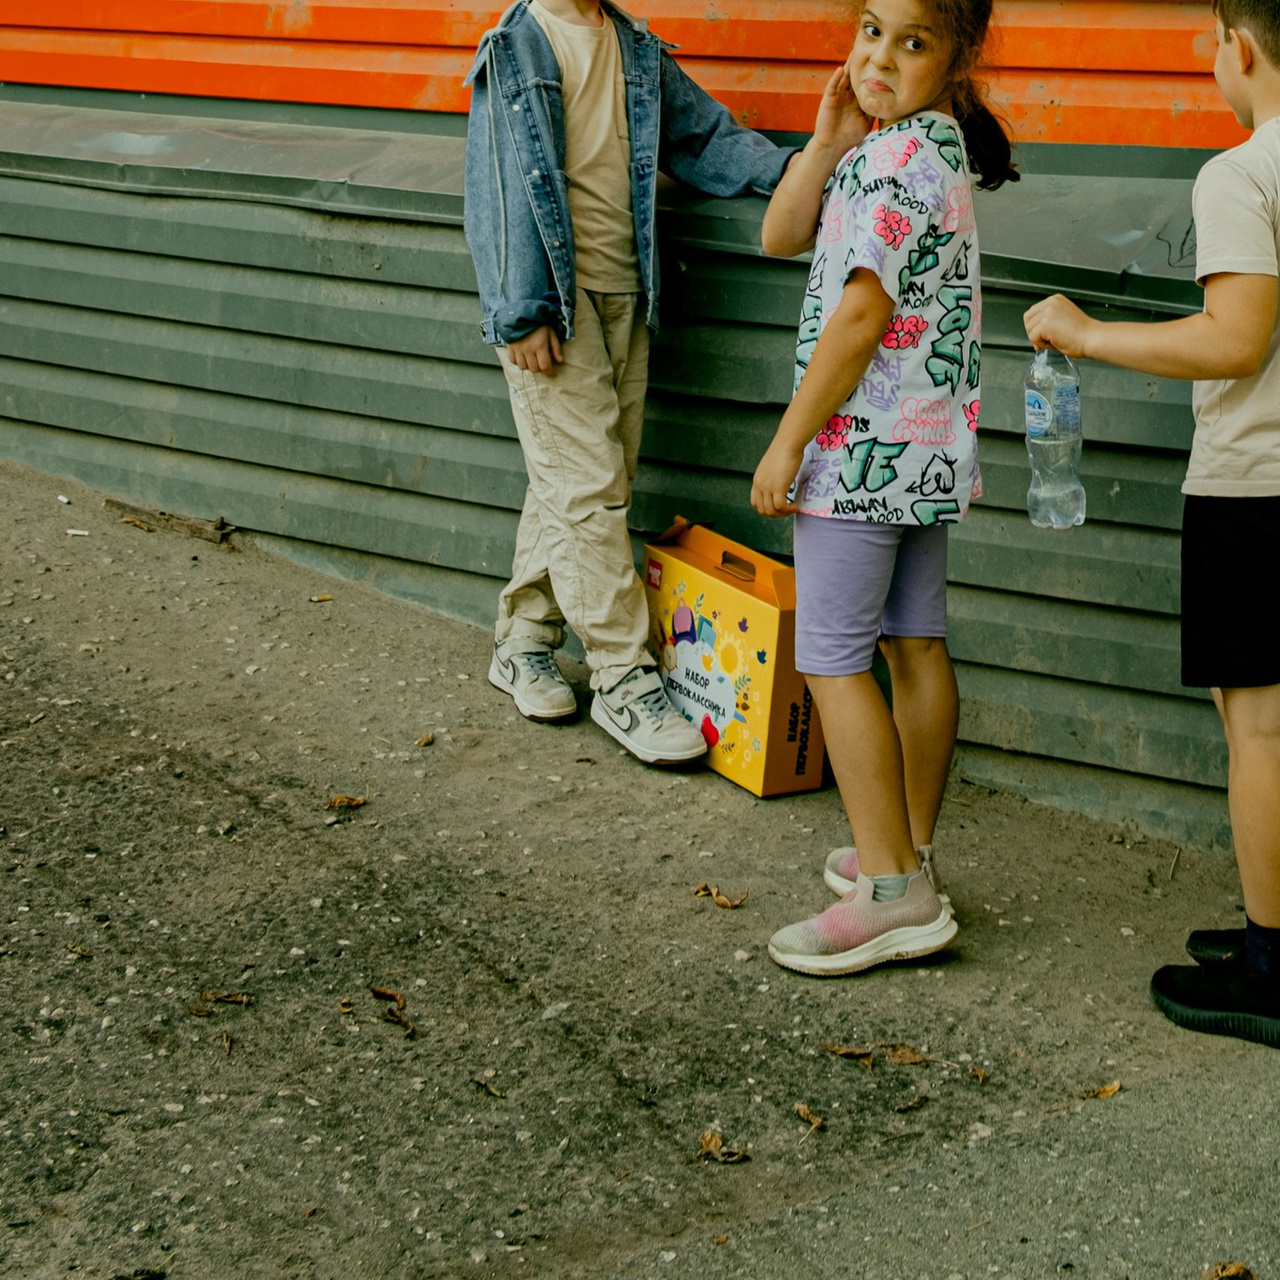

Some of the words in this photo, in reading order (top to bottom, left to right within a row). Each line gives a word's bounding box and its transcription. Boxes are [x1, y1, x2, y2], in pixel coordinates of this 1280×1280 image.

[666, 676, 726, 718] ПЕРВОКЛАССНИКА
[685, 666, 710, 690] НАБОР
[787, 701, 801, 742] НАБОР
